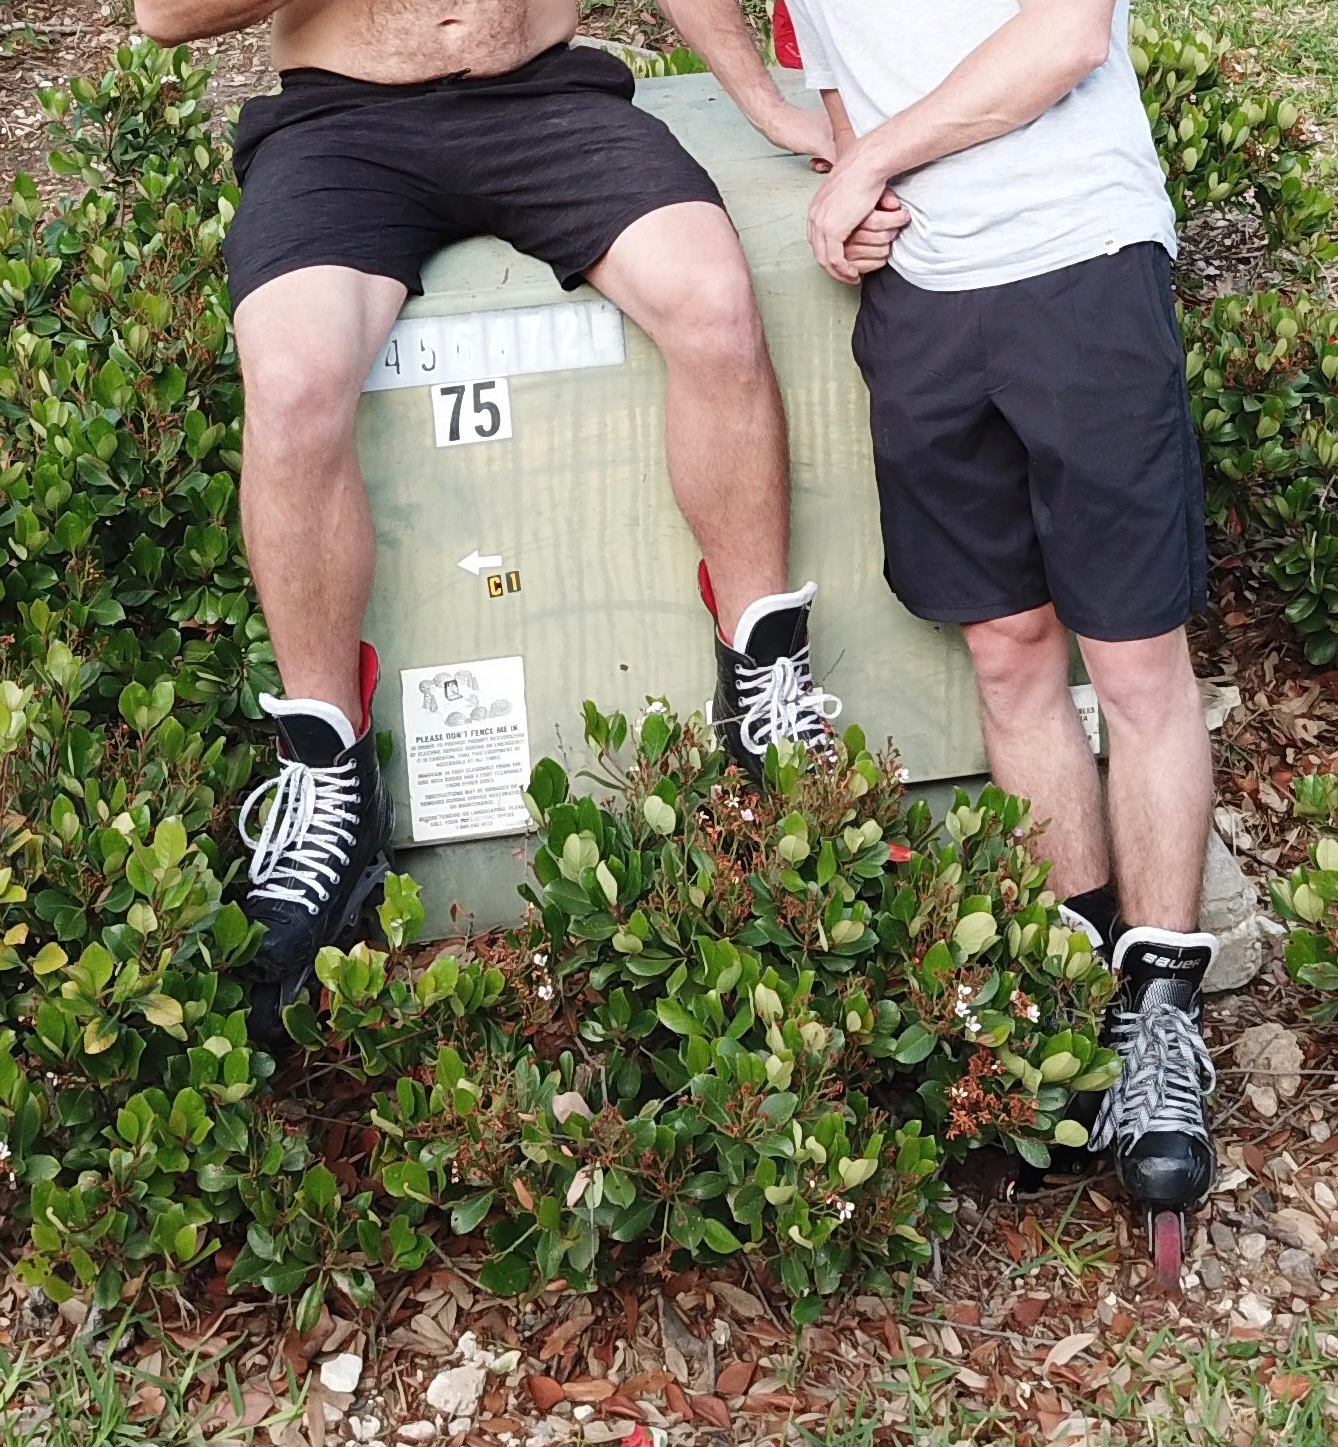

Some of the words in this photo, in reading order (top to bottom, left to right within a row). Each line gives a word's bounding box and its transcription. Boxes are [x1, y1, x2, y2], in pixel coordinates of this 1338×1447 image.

[440, 380, 501, 442] 75
[415, 733, 443, 744] PLEASE
[446, 730, 468, 741] DON'T
[470, 726, 494, 737] FENCE
[496, 725, 508, 734] ME
[510, 724, 518, 732] IN
